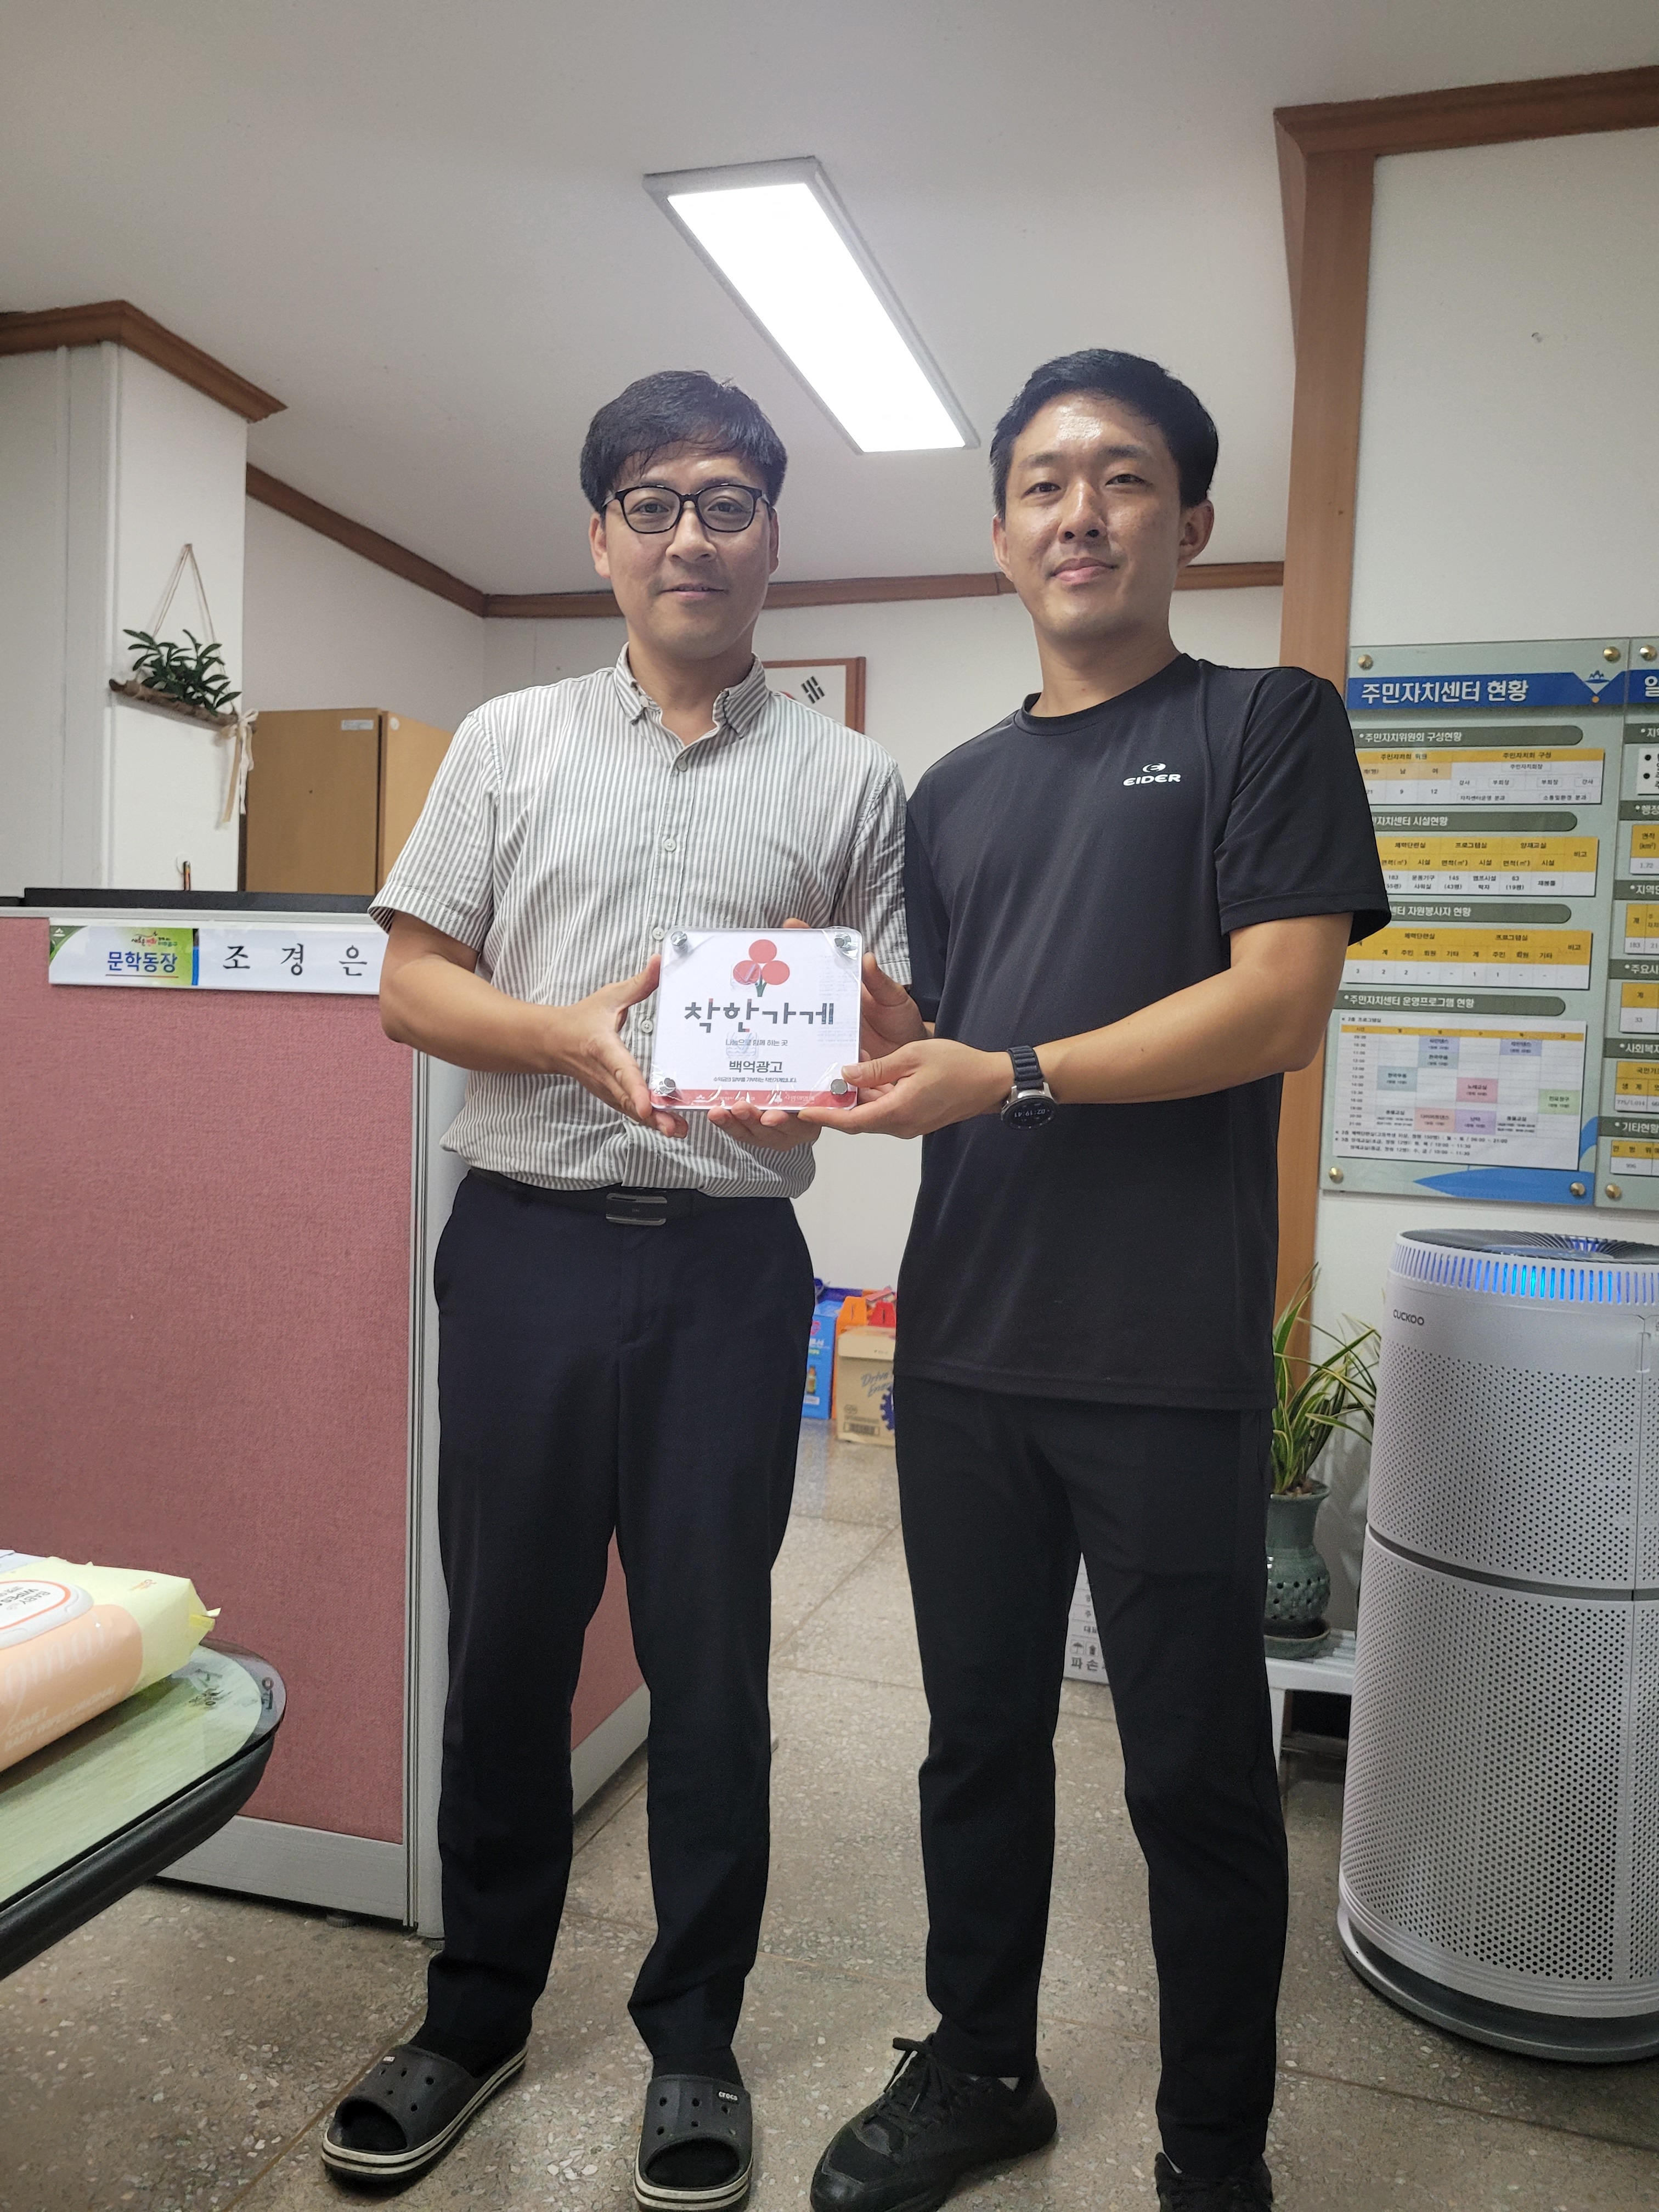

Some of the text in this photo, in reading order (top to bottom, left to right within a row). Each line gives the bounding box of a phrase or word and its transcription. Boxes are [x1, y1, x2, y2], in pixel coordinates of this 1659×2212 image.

[1362, 680, 1529, 704] 주민자치센터 현황
[1365, 732, 1462, 742] 주민자치위원회 구성현황
[1123, 774, 1181, 786] EIDER
[1413, 816, 1448, 826] 시설현황
[1408, 907, 1451, 916] 자원봉사자
[1454, 907, 1471, 917] 현황
[107, 952, 178, 973] 문학동장
[223, 944, 368, 976] 조 경 은
[1350, 995, 1474, 1008] 주민자치센터 운영프로그램 현황
[684, 998, 834, 1033] 착한가게
[729, 1060, 783, 1073] 백억광고
[1393, 1310, 1424, 1325] CUCKOO
[1071, 1657, 1098, 1671] 파 손
